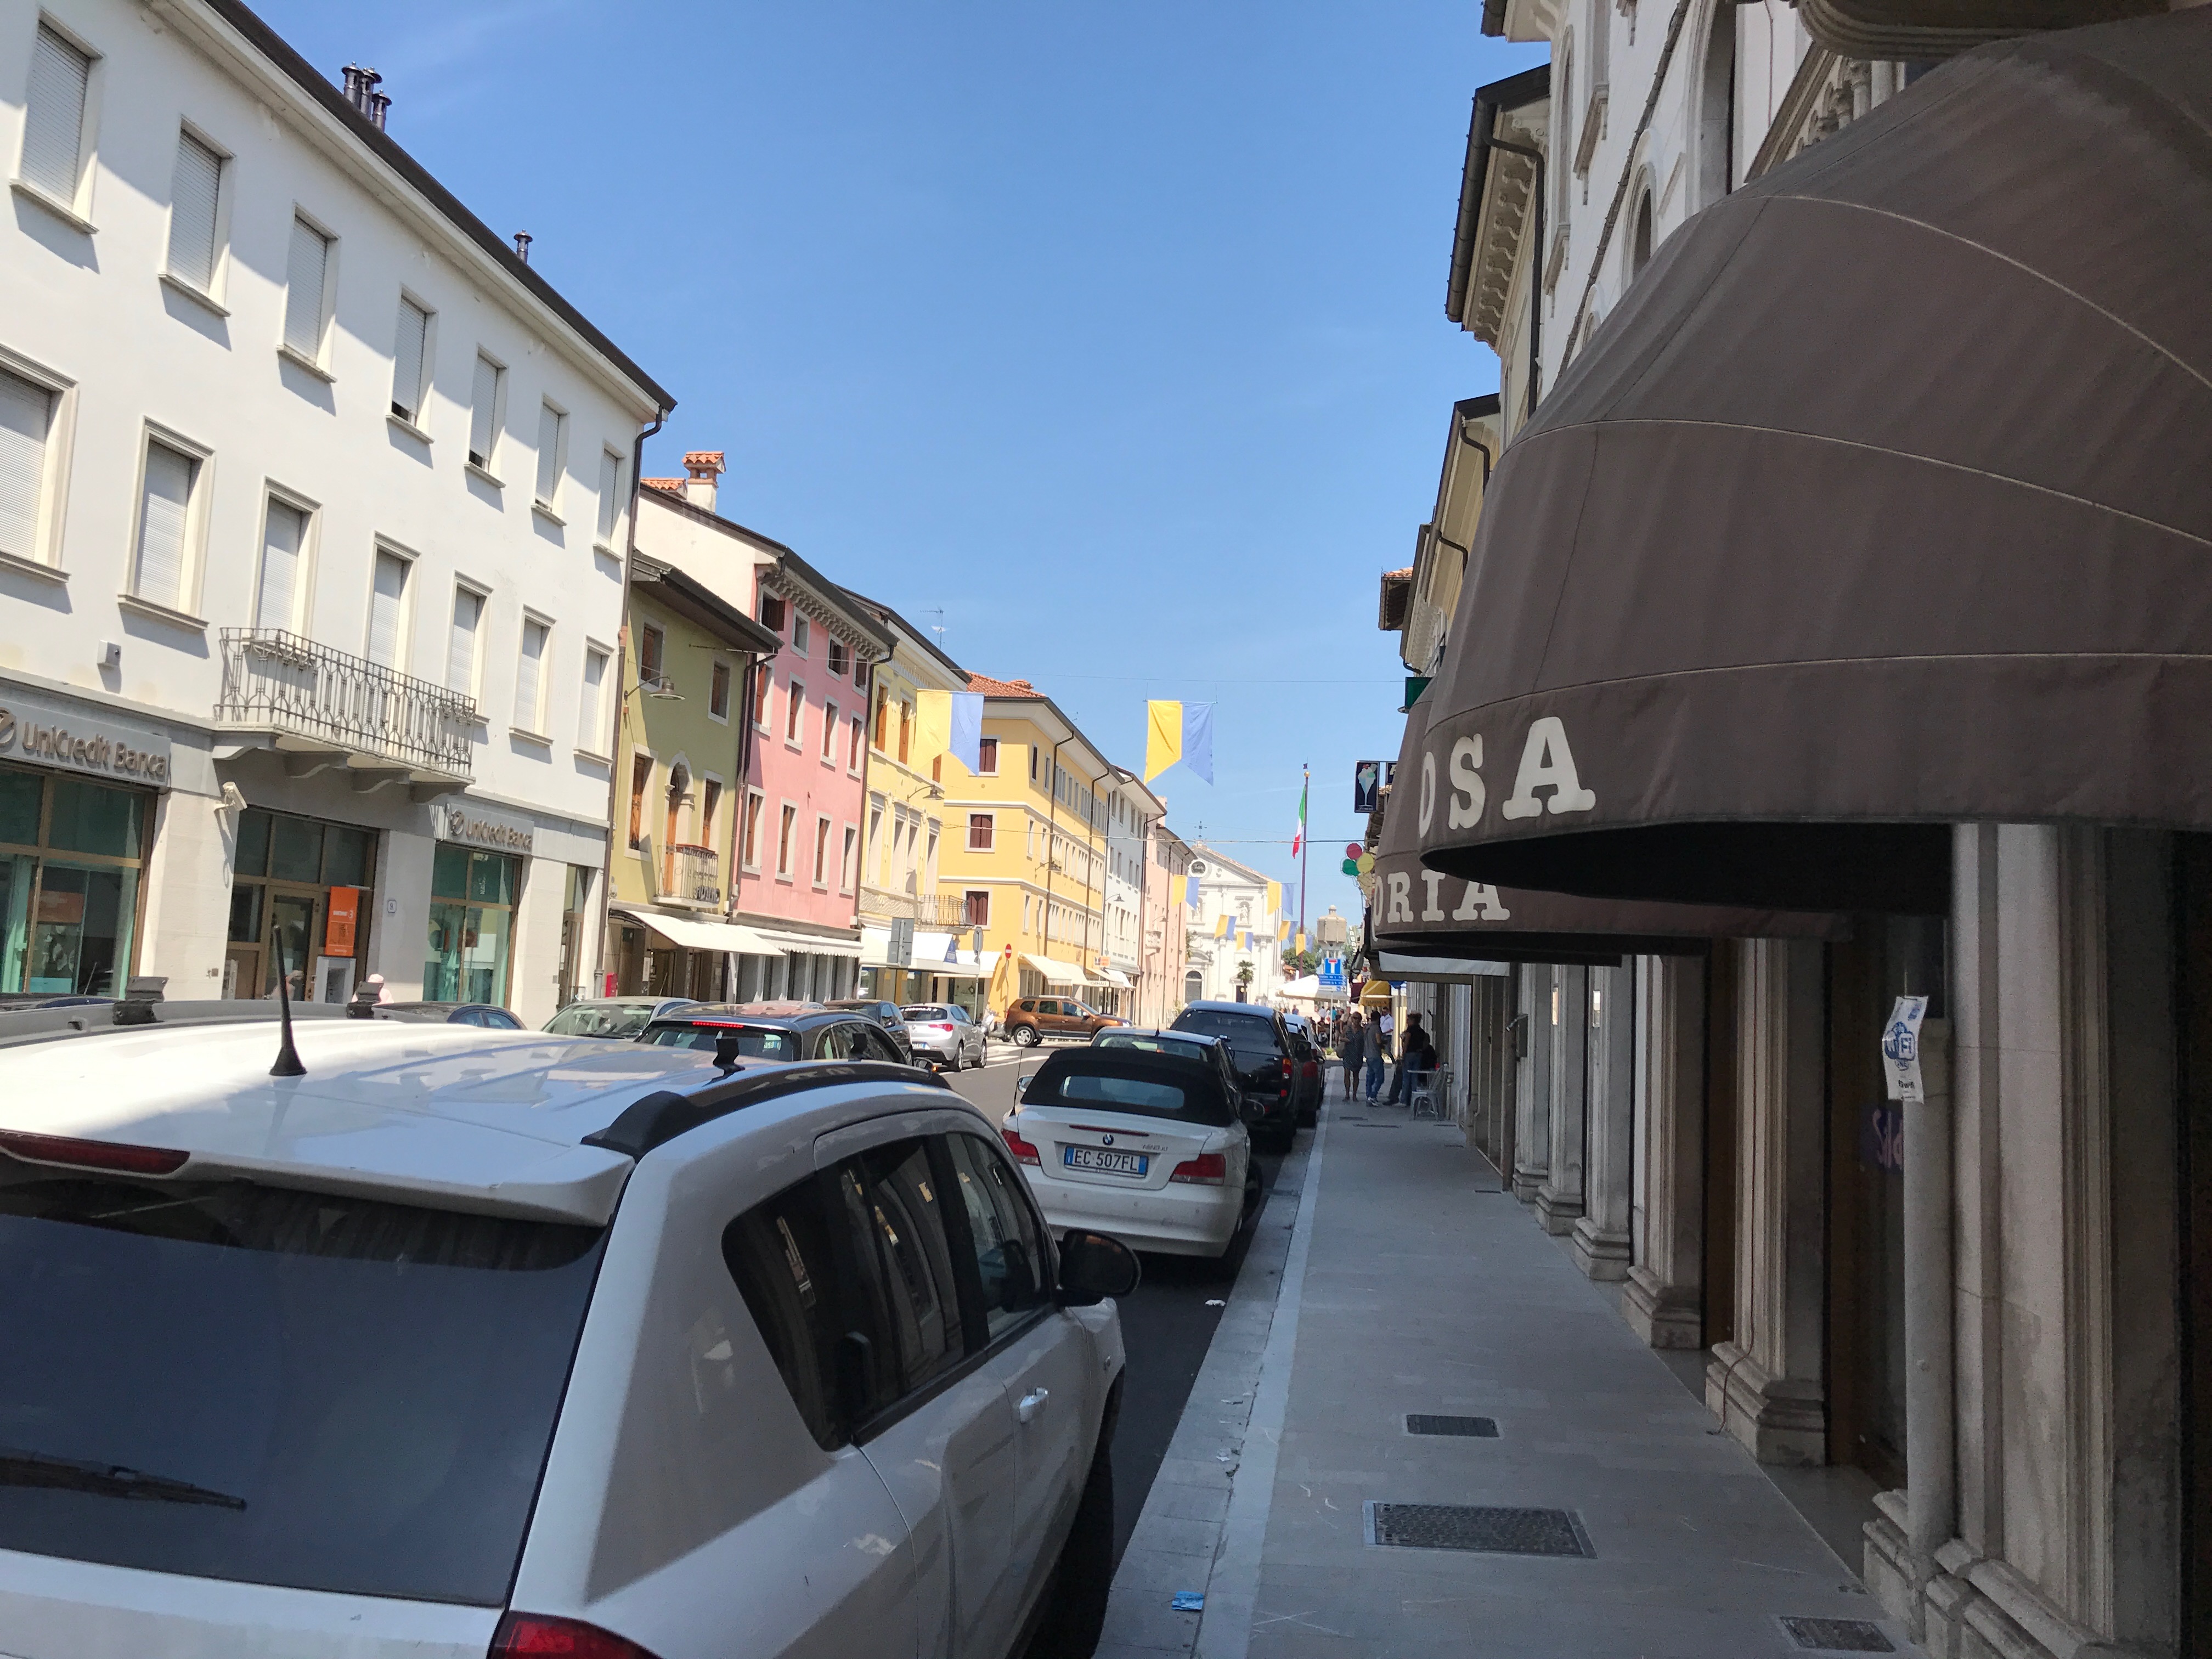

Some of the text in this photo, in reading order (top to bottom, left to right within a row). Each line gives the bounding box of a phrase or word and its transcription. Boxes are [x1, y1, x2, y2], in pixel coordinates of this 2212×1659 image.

[22, 721, 166, 776] UniCredit Banca
[467, 819, 532, 849] UniCredit Banca
[1074, 1150, 1137, 1171] EC 507FL
